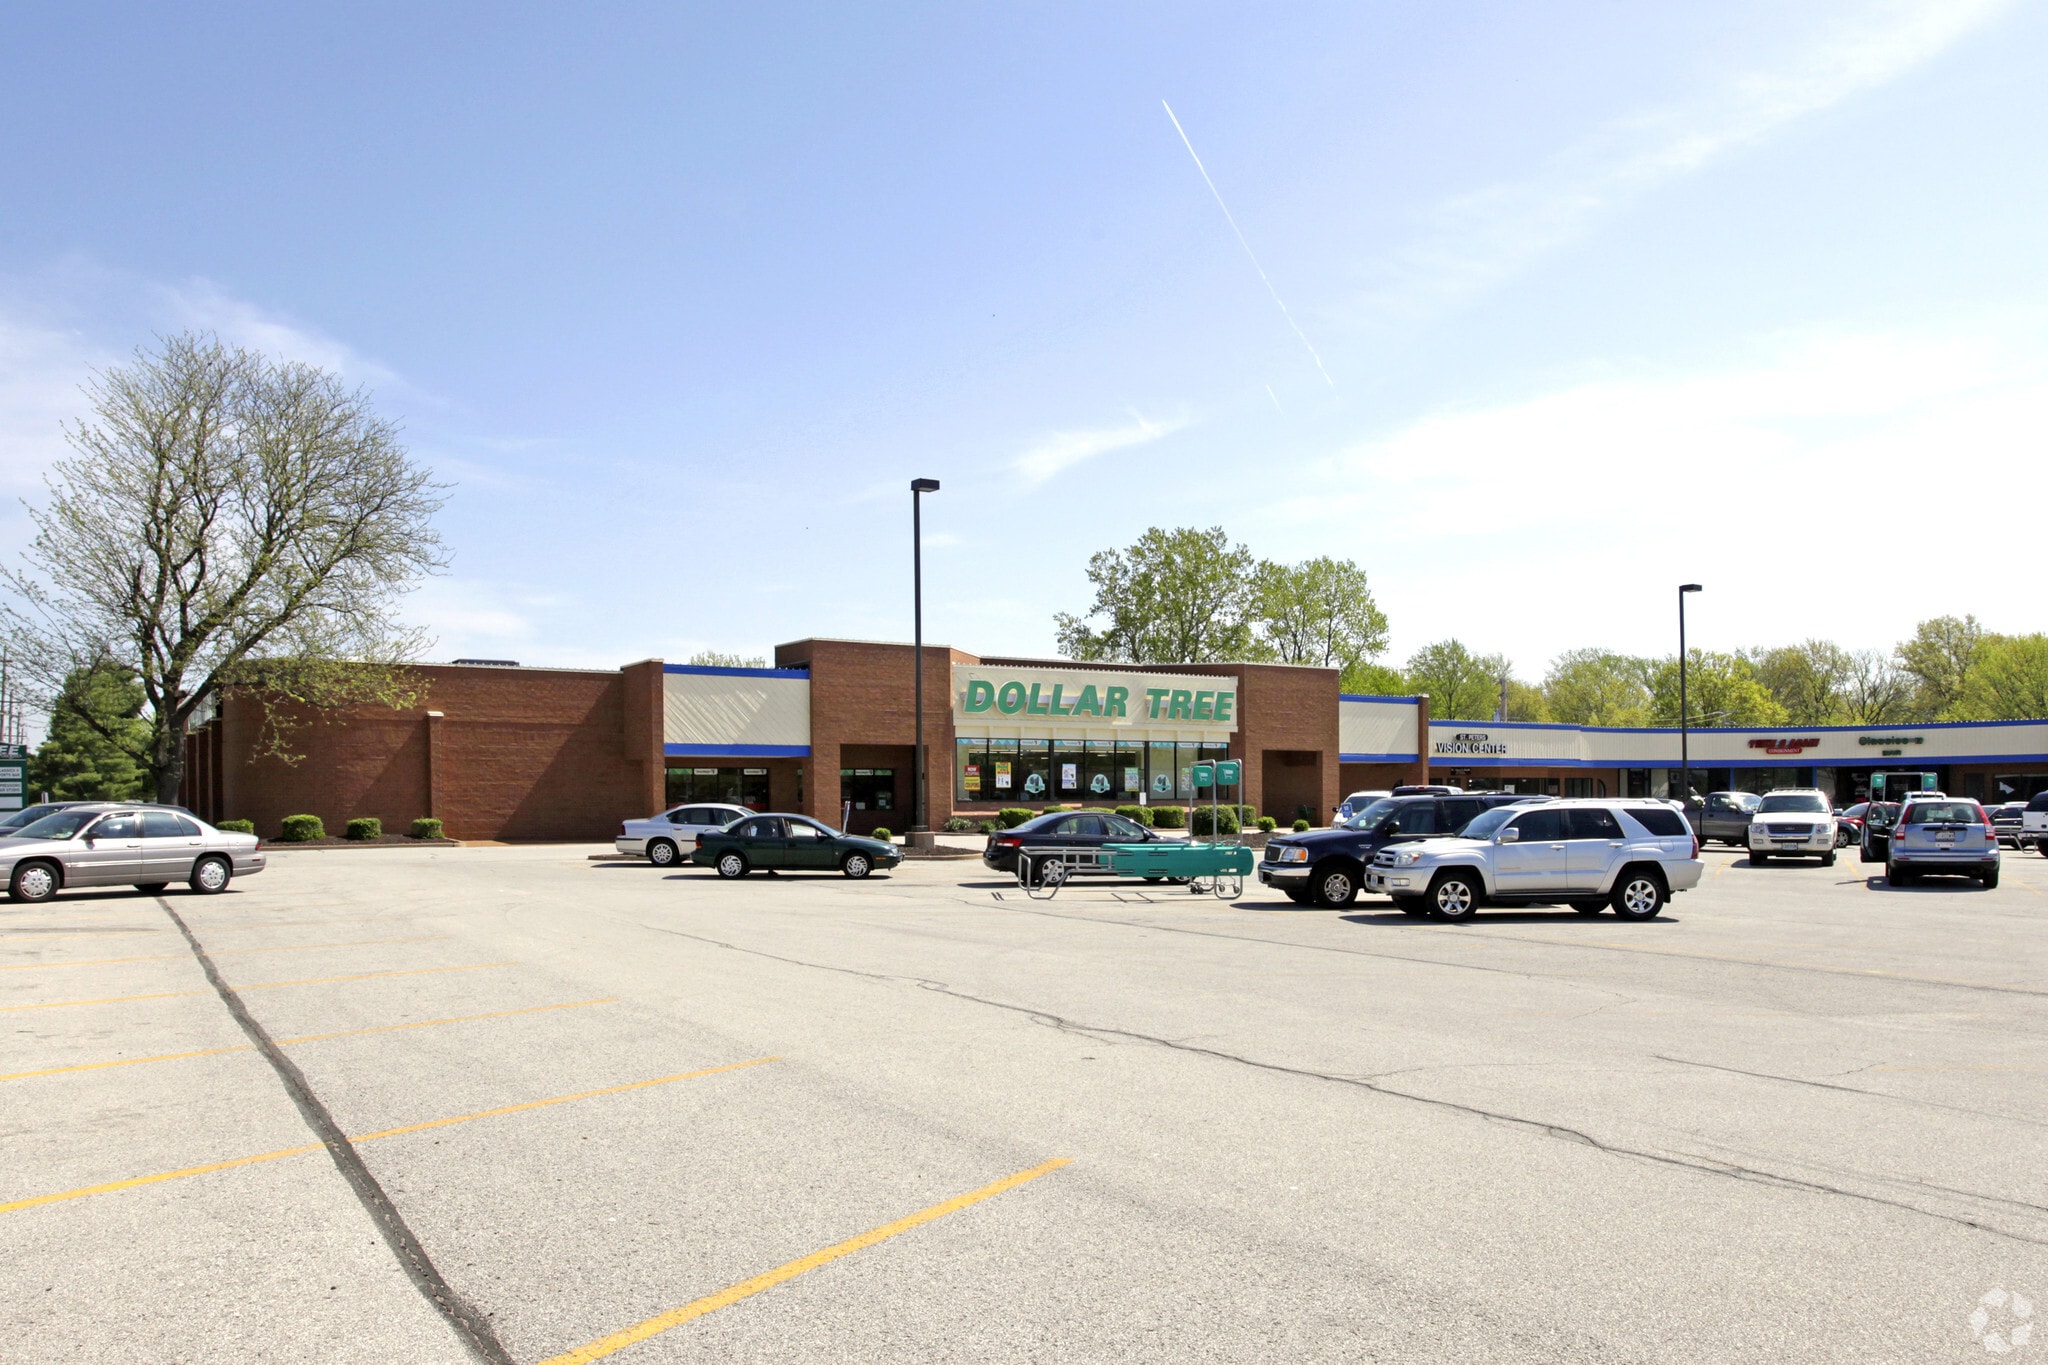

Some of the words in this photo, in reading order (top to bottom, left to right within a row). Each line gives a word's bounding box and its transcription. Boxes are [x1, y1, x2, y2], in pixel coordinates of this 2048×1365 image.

[963, 679, 1129, 718] DOLLAR
[1146, 687, 1235, 722] TREE
[1437, 742, 1468, 753] VISION
[1471, 742, 1507, 754] CENTER
